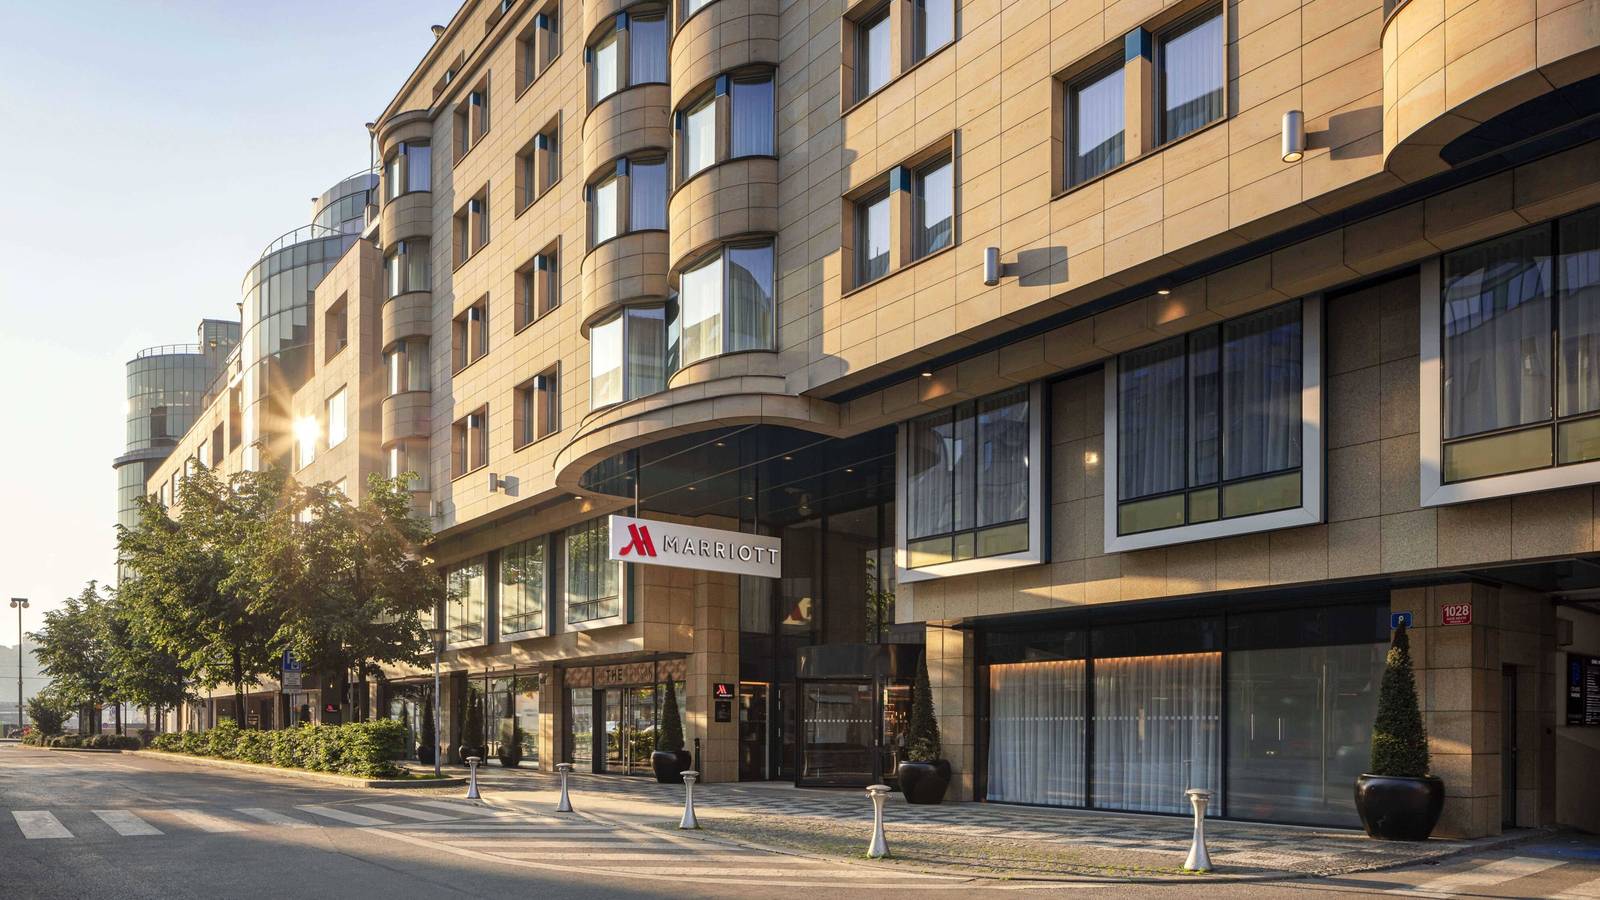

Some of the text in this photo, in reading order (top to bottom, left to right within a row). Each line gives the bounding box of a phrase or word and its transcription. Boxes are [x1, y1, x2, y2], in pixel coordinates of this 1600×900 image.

[663, 535, 779, 565] MARRIOTT
[1444, 605, 1469, 617] 1028
[606, 668, 623, 681] THE
